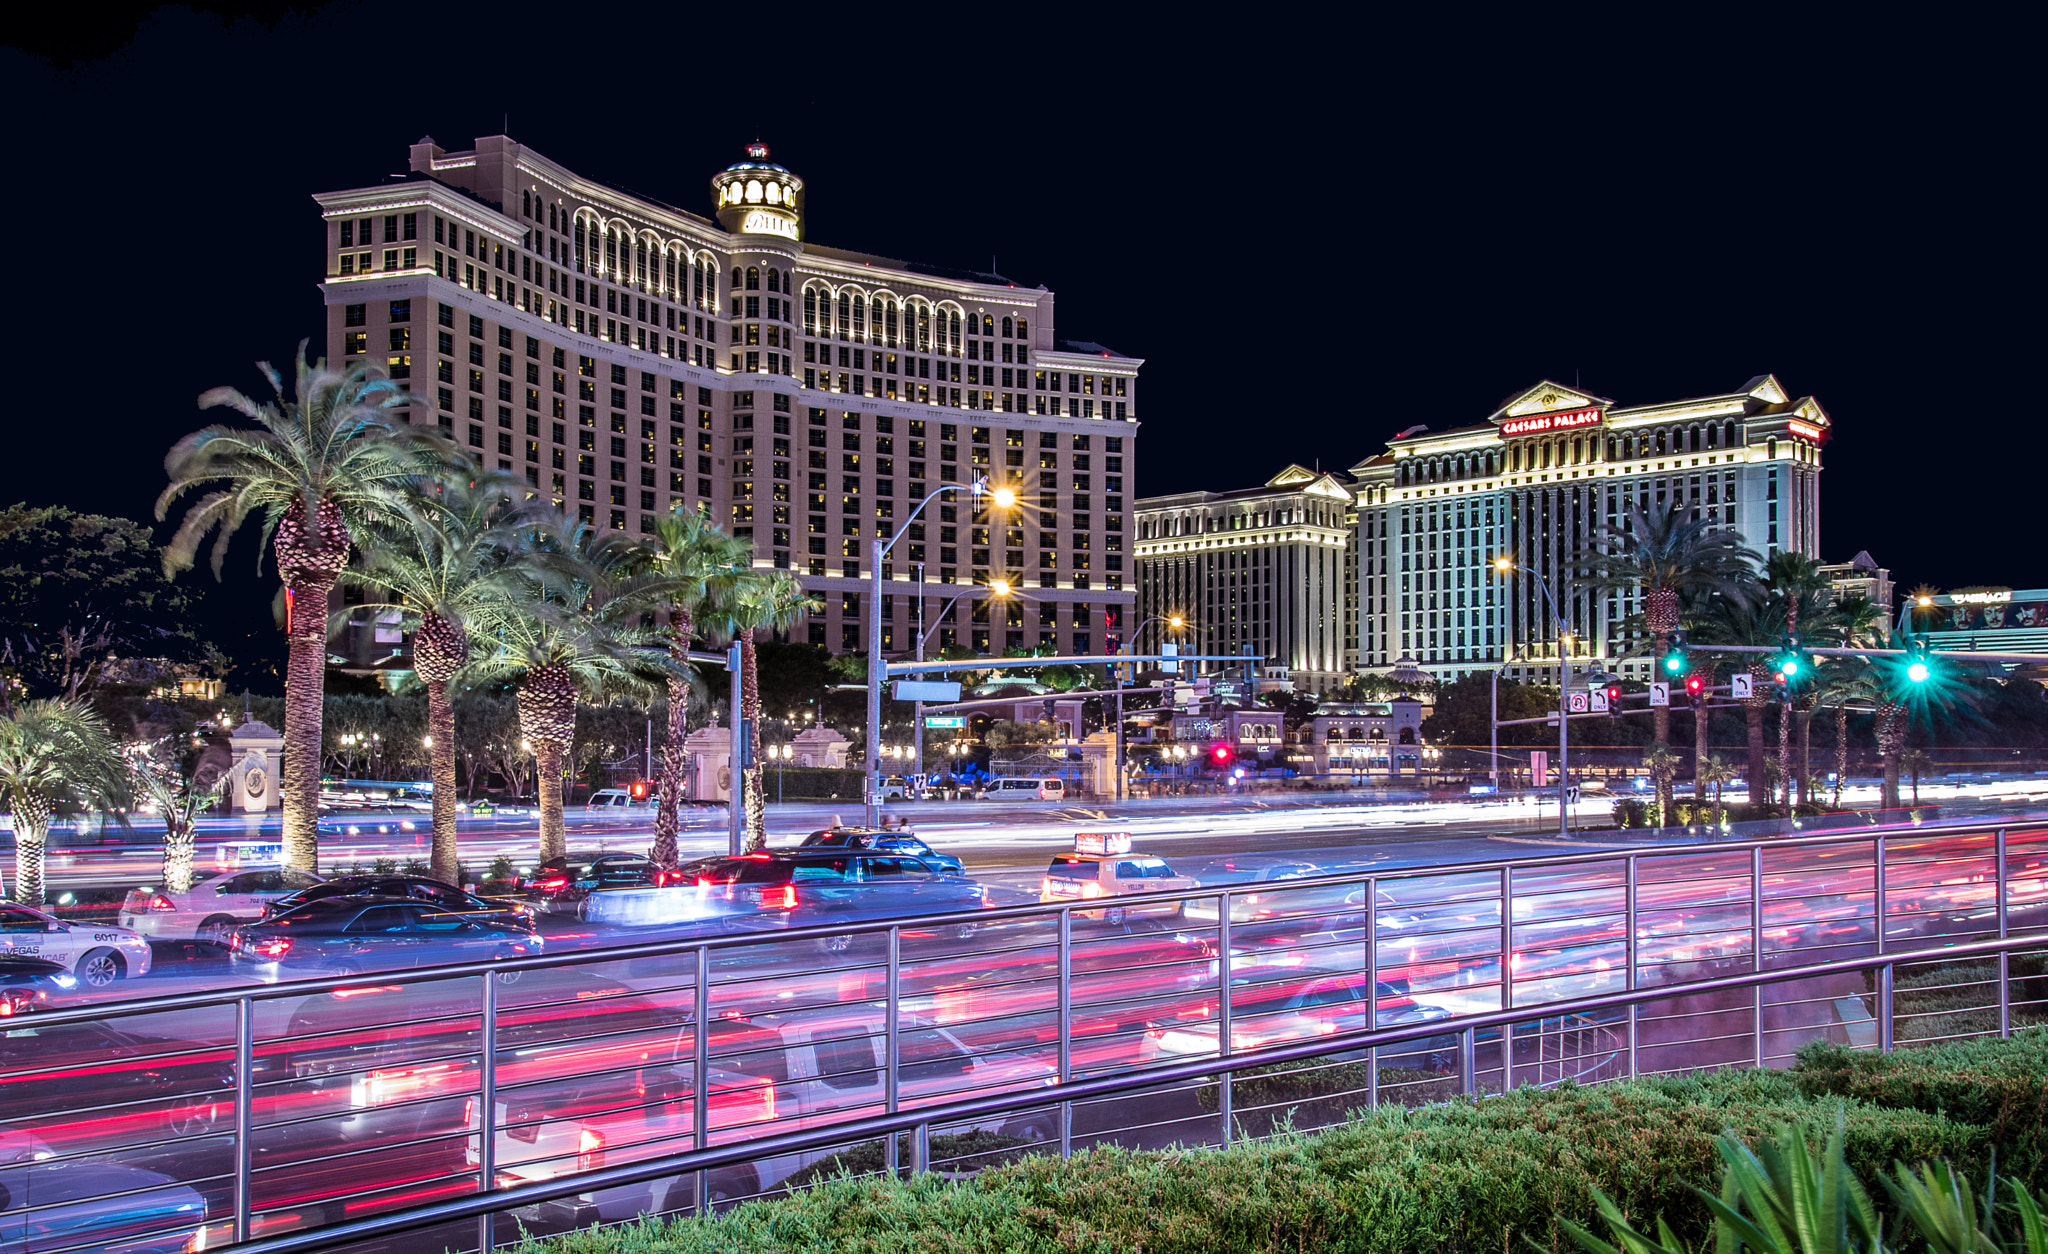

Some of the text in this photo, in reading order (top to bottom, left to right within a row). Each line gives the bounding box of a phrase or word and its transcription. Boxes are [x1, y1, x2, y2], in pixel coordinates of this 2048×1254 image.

[1503, 411, 1598, 434] CAESARS PALACE
[1963, 591, 2012, 604] MIRAGE
[94, 933, 118, 942] 6017
[5, 946, 40, 955] VEGAS
